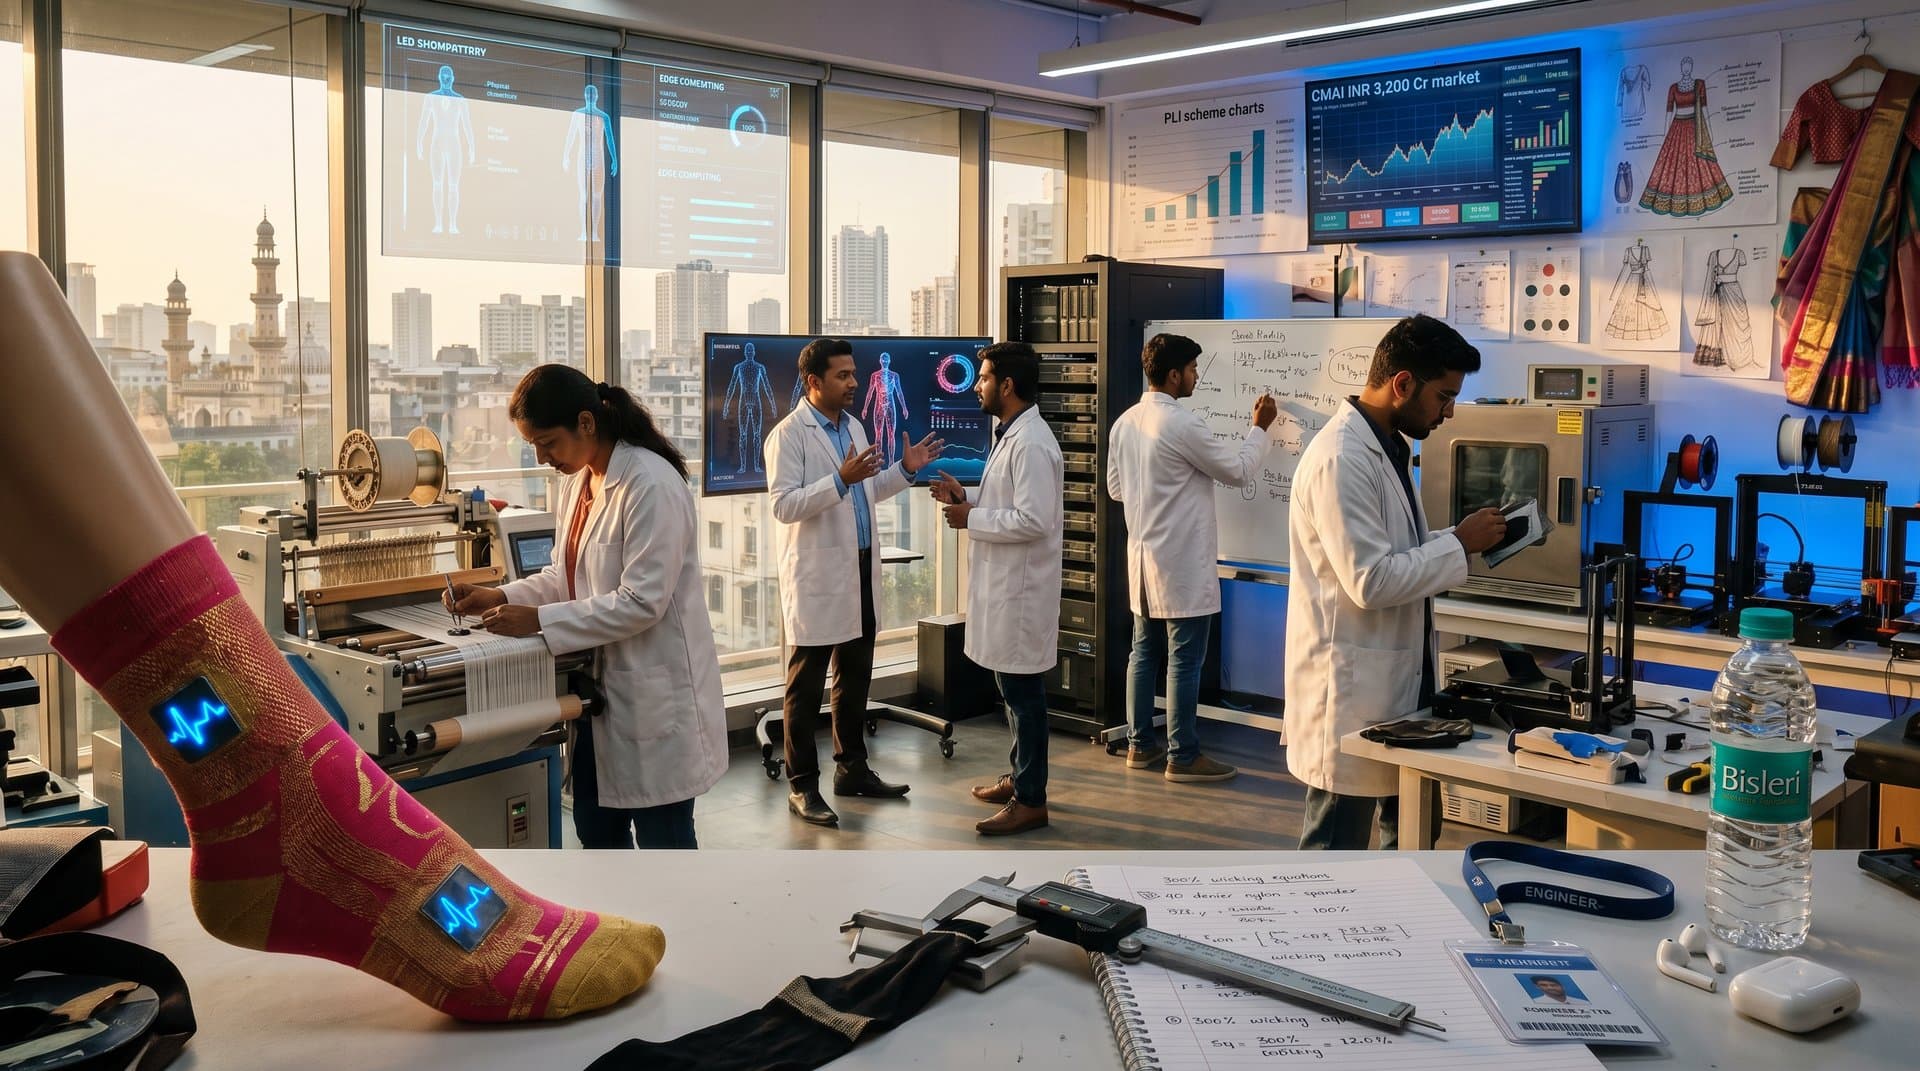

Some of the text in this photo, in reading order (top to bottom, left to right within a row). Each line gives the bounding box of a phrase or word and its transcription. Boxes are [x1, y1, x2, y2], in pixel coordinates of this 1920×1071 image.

[397, 36, 487, 57] LED SHOMPATTRRY
[660, 75, 679, 85] EDGE
[1311, 70, 1481, 102] CMAI INR 3,200 Cr market
[1184, 108, 1226, 122] scheme
[1229, 102, 1265, 117] charts
[1722, 765, 1801, 796] Bisleri
[1211, 874, 1264, 884] wicking
[1245, 891, 1280, 901] nylon
[1525, 886, 1598, 910] ENGINEER
[1272, 952, 1325, 961] wicking
[1192, 1016, 1236, 1025] 300%
[1250, 1015, 1309, 1027] wicking
[1257, 1035, 1299, 1045] 300%
